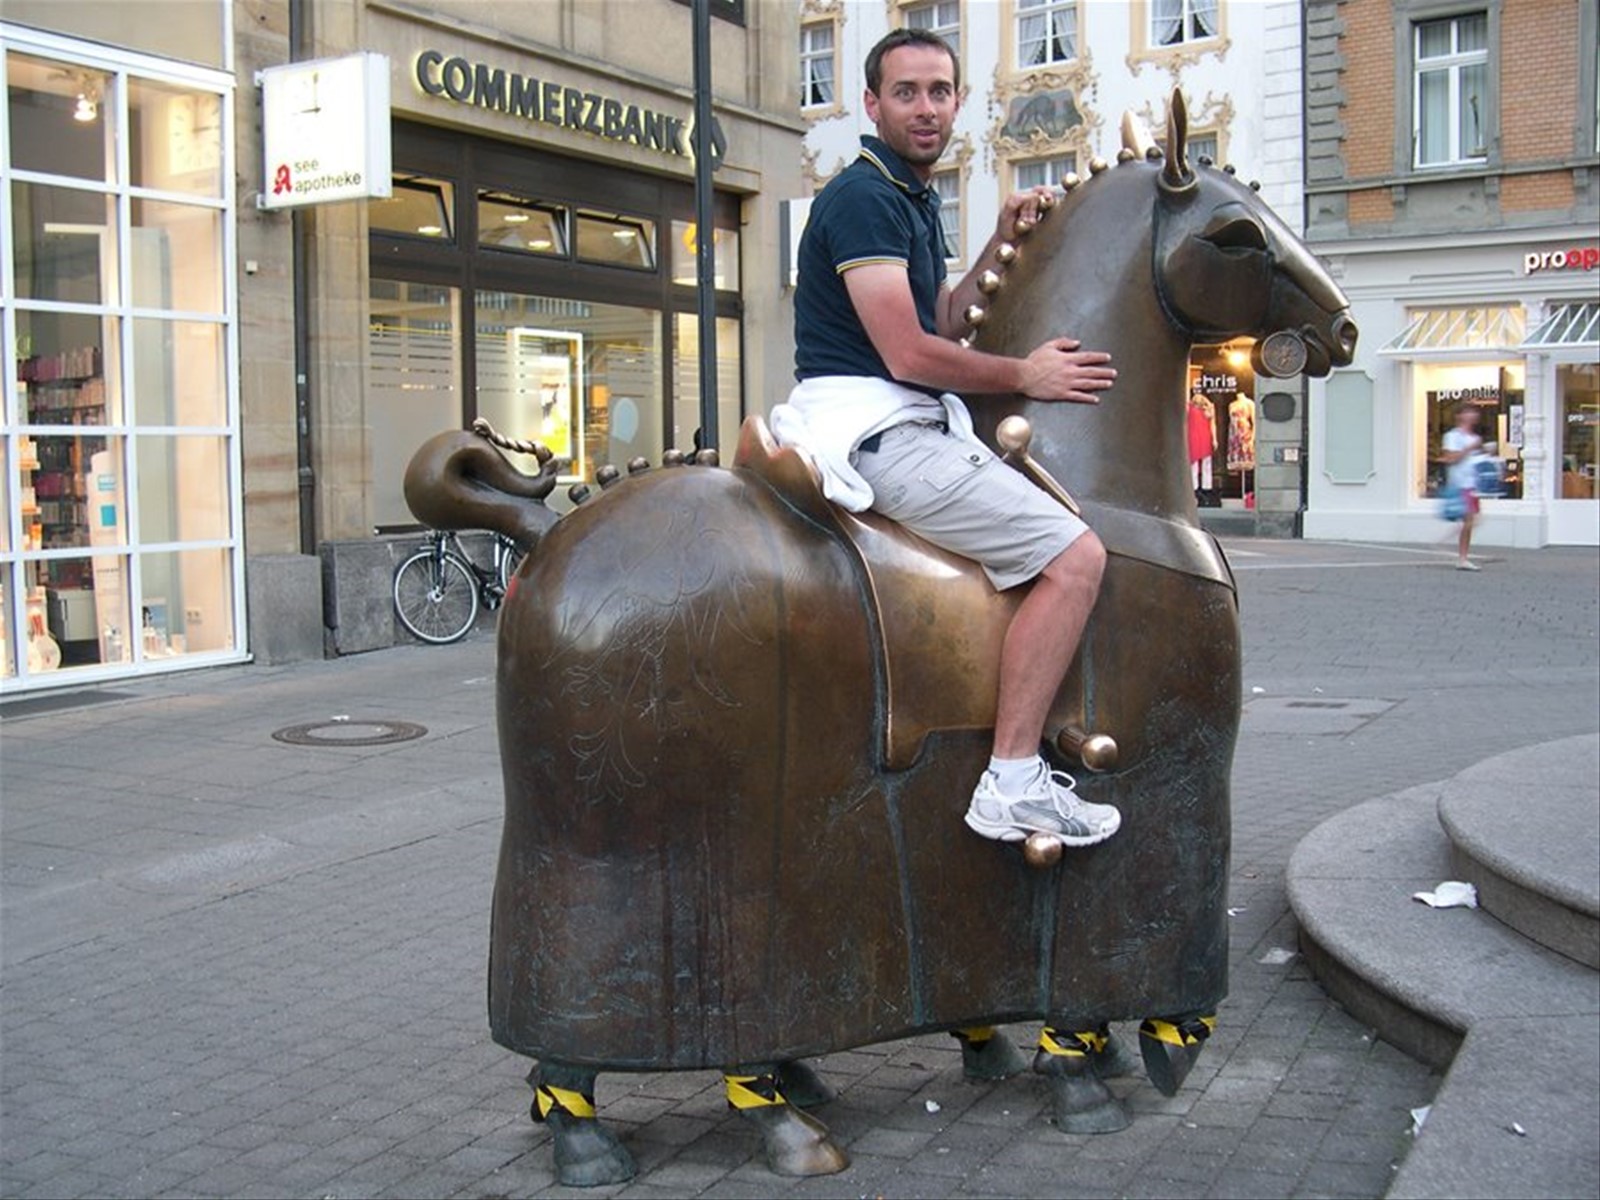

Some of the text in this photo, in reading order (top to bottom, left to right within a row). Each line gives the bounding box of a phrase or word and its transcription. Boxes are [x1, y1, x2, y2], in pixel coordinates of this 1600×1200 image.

[416, 50, 686, 155] COMMERZBANK
[294, 159, 319, 173] see
[295, 171, 362, 194] apotheke
